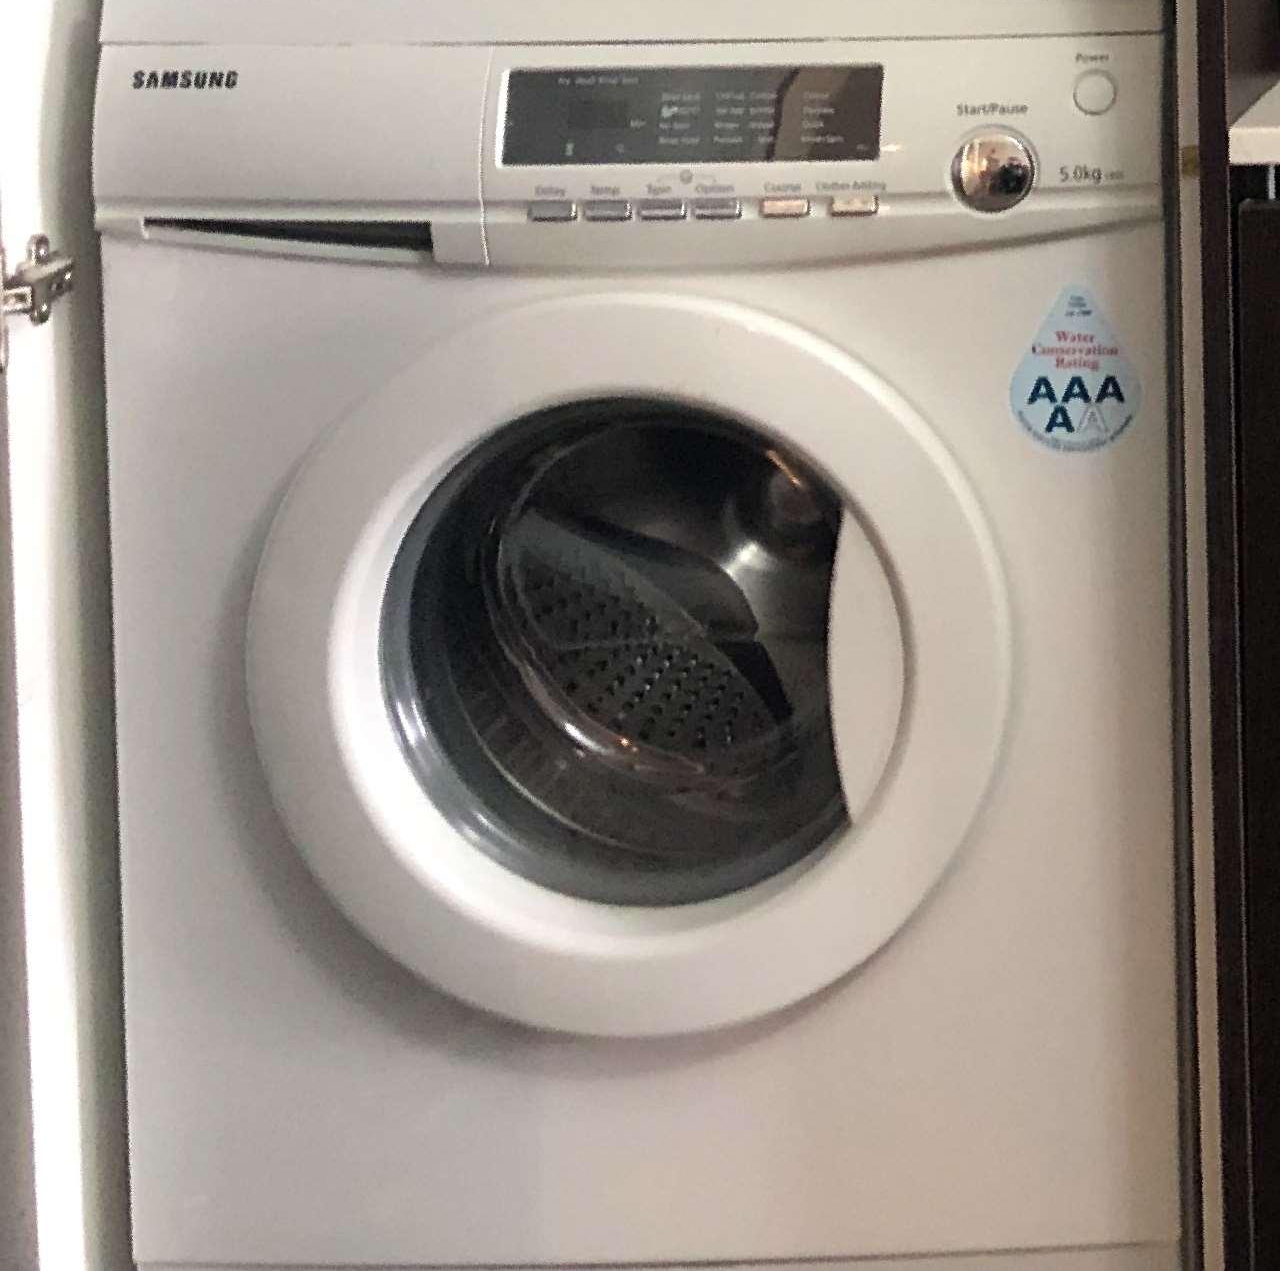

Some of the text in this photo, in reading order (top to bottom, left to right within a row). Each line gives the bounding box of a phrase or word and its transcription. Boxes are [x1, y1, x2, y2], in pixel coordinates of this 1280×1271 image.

[1075, 53, 1109, 63] Power
[132, 70, 239, 90] SAMSUNG
[957, 102, 1029, 116] Start/Pause
[1055, 331, 1095, 343] Water
[1031, 345, 1119, 356] Conservation
[1055, 356, 1100, 371] Rating
